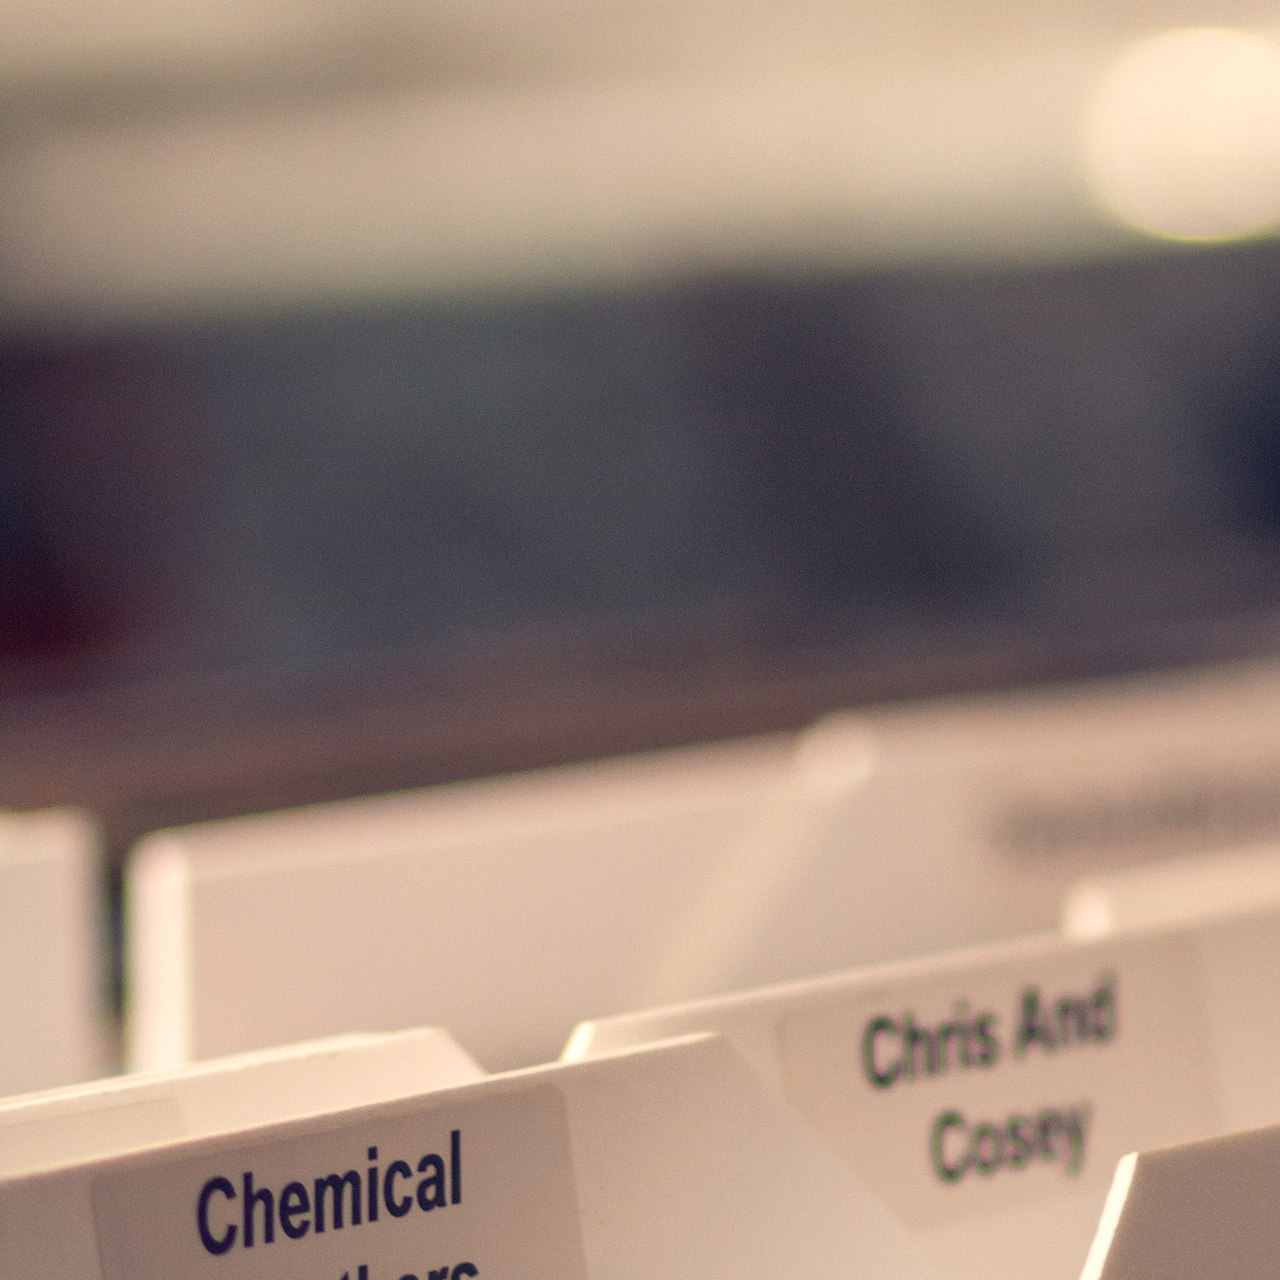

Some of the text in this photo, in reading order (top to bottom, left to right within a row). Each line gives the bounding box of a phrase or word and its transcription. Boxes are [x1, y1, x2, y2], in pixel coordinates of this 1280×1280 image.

[861, 968, 1119, 1089] Chris And
[196, 1129, 463, 1256] Chemical
[930, 1101, 1093, 1184] Cosey
